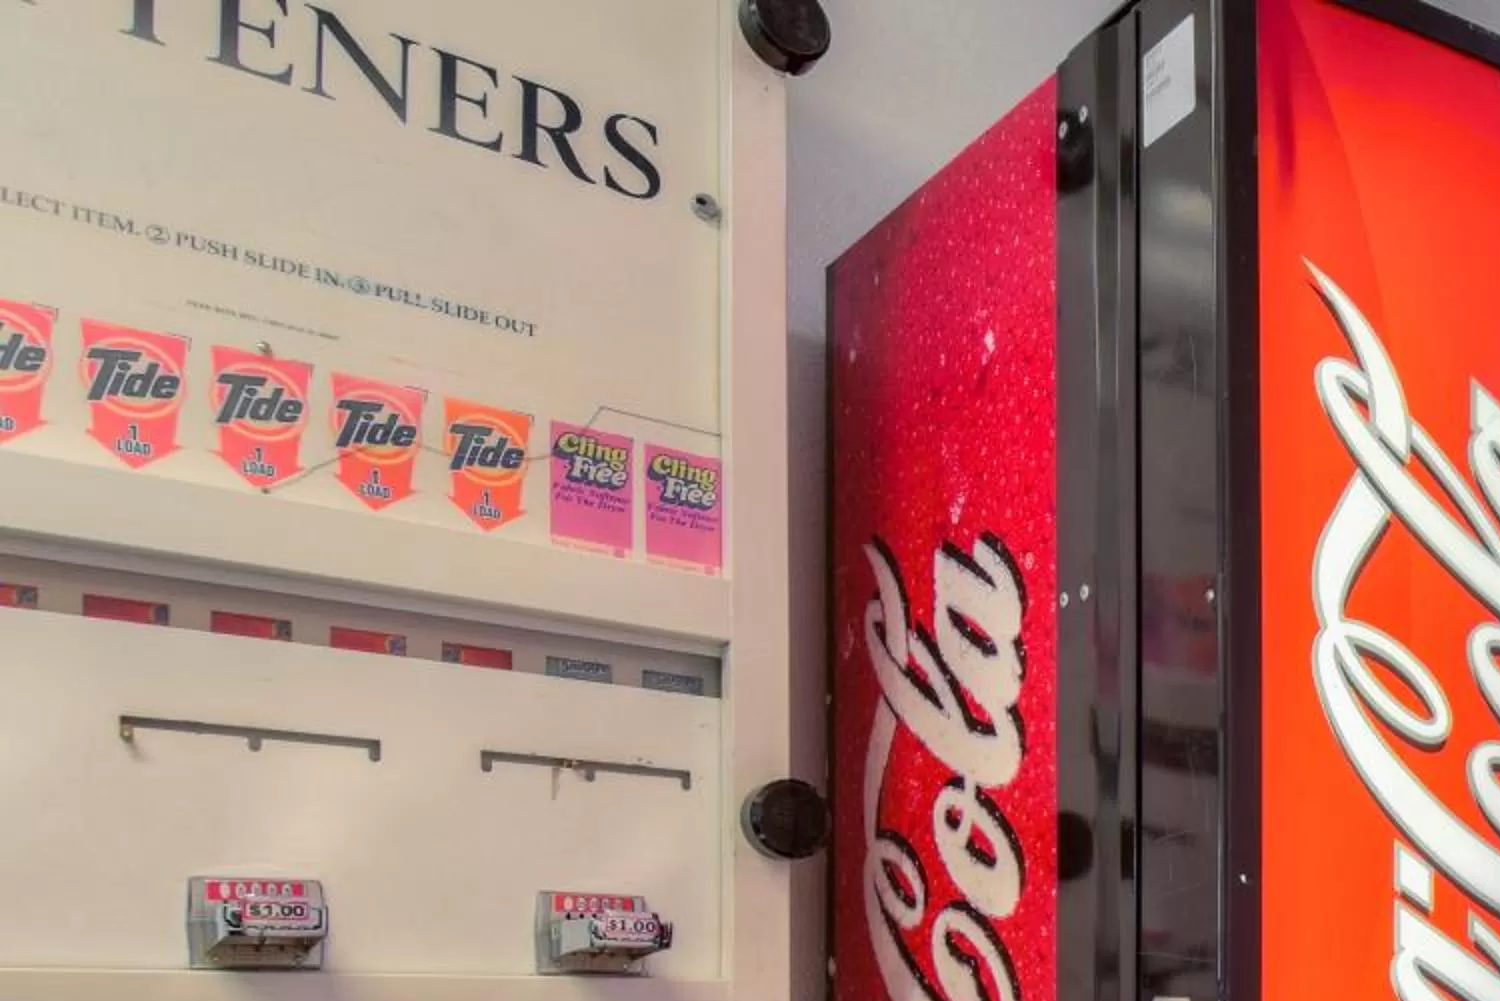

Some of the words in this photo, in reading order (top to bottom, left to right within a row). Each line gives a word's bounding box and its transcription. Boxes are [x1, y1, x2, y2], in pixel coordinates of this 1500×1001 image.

[72, 205, 141, 236] ITEM.
[175, 231, 238, 261] PUSH
[244, 248, 310, 279] SLIDE
[375, 283, 428, 309] PULL
[431, 297, 491, 325] SLIDE
[495, 313, 538, 337] OUT
[87, 347, 181, 401] Tide
[215, 373, 303, 424] Tide
[336, 399, 417, 447] Tide
[128, 424, 138, 441] 1
[117, 439, 151, 456] LOAD
[254, 447, 262, 463] 1
[449, 423, 525, 470] Tide
[556, 432, 628, 472] Cling
[243, 461, 275, 478] LOAD
[372, 470, 380, 485] 1
[570, 455, 628, 487] Free
[651, 455, 717, 492] Cling
[359, 484, 391, 500] LOAD
[482, 491, 490, 505] 1
[664, 476, 717, 507] Free
[472, 506, 502, 521] LOAD
[250, 905, 305, 918] $1.00
[608, 918, 657, 933] $1.00
